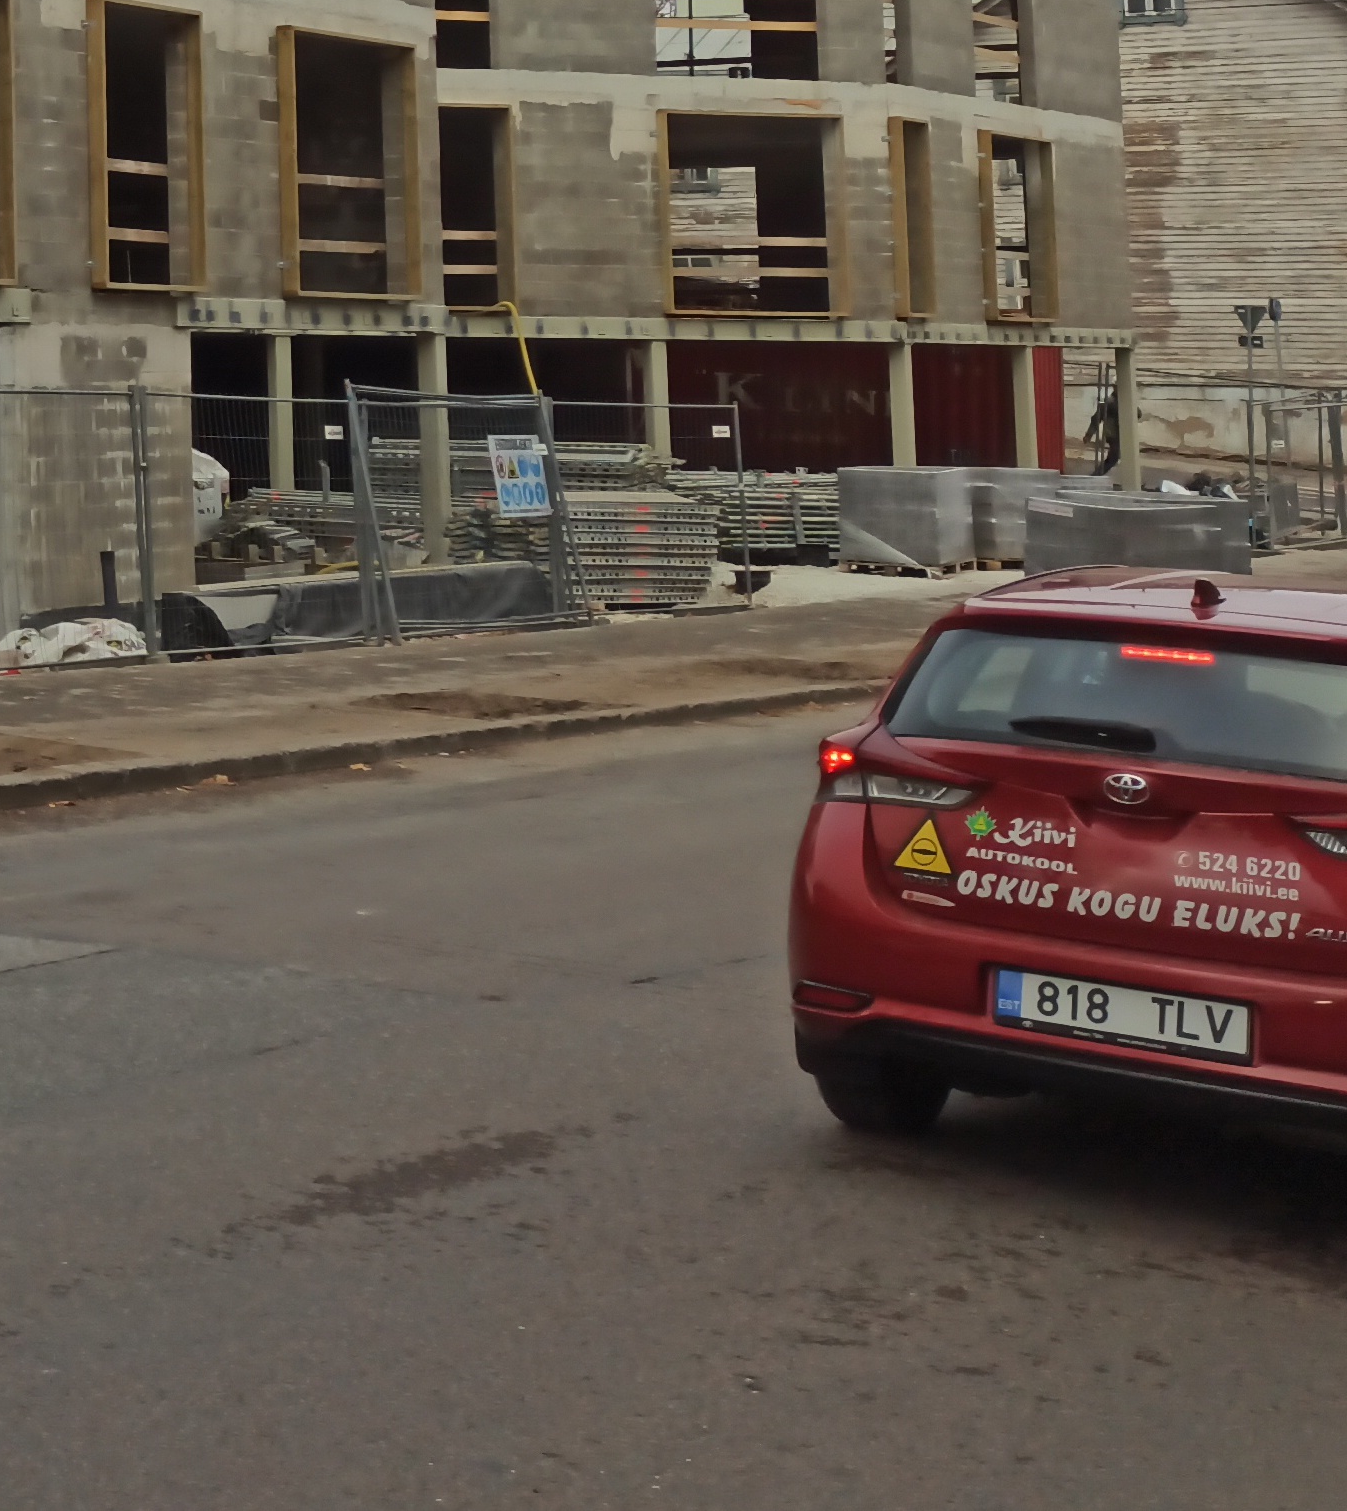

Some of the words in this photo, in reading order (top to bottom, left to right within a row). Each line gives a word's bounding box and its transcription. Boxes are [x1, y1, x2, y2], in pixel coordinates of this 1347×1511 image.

[993, 817, 1077, 848] Kiivi
[965, 847, 1078, 875] AUTOKOOL
[1198, 851, 1239, 874] 524
[1245, 856, 1301, 881] 6220
[1174, 874, 1300, 901] www.kiivi.ee
[957, 869, 1060, 909] OSKUS
[1066, 886, 1162, 923] KOGU
[1171, 899, 1302, 940] ELUKS!
[1037, 980, 1109, 1024] 818
[1151, 996, 1234, 1044] TLV
